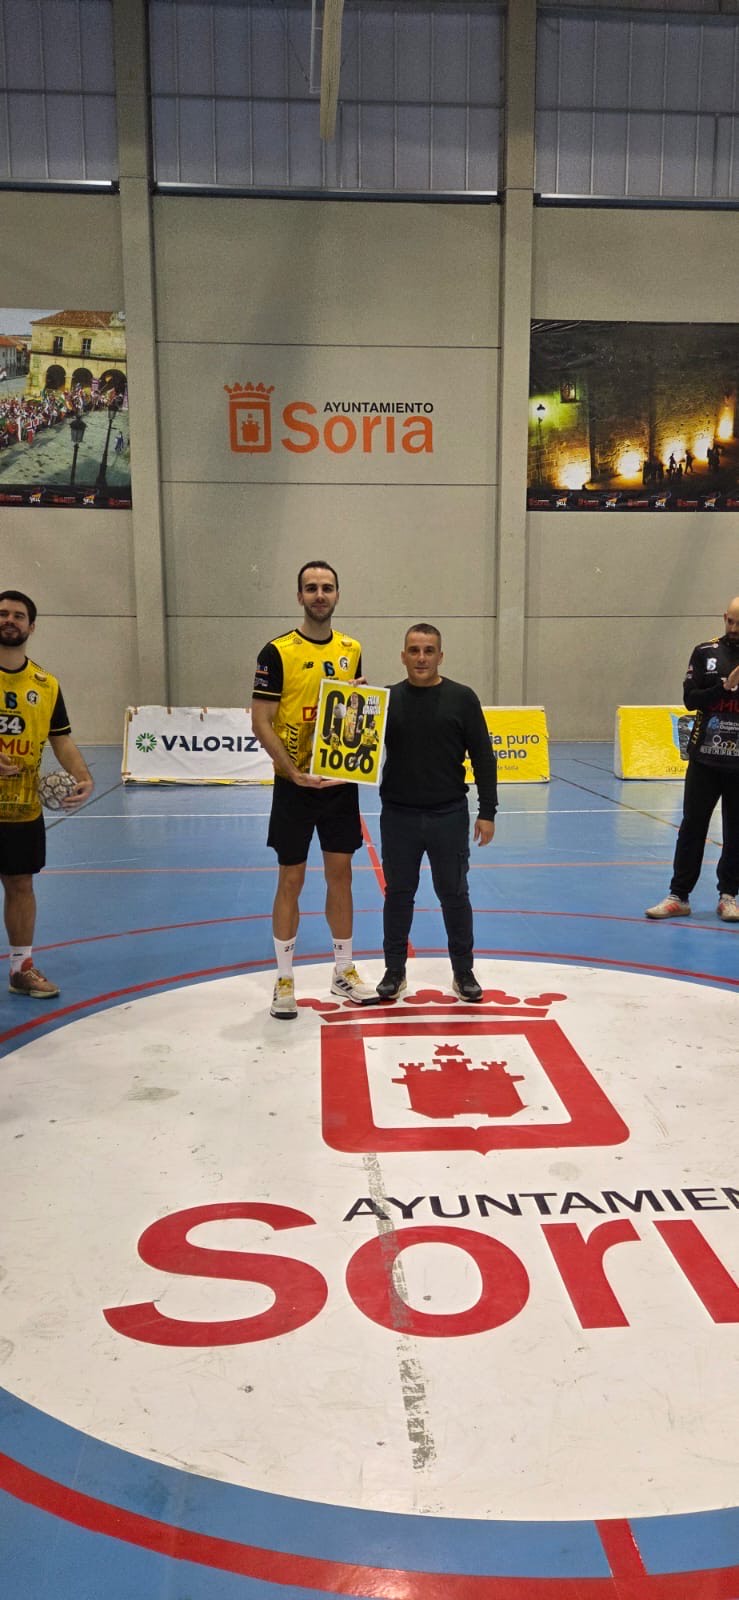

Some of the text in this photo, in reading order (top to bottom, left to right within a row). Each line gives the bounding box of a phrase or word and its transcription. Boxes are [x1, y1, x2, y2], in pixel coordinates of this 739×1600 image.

[324, 402, 434, 413] AYUNTAMIENTO
[281, 402, 434, 454] Soria
[0, 717, 22, 733] 34
[161, 735, 266, 752] VALORIZ
[507, 735, 540, 748] puro
[320, 748, 374, 774] 1000
